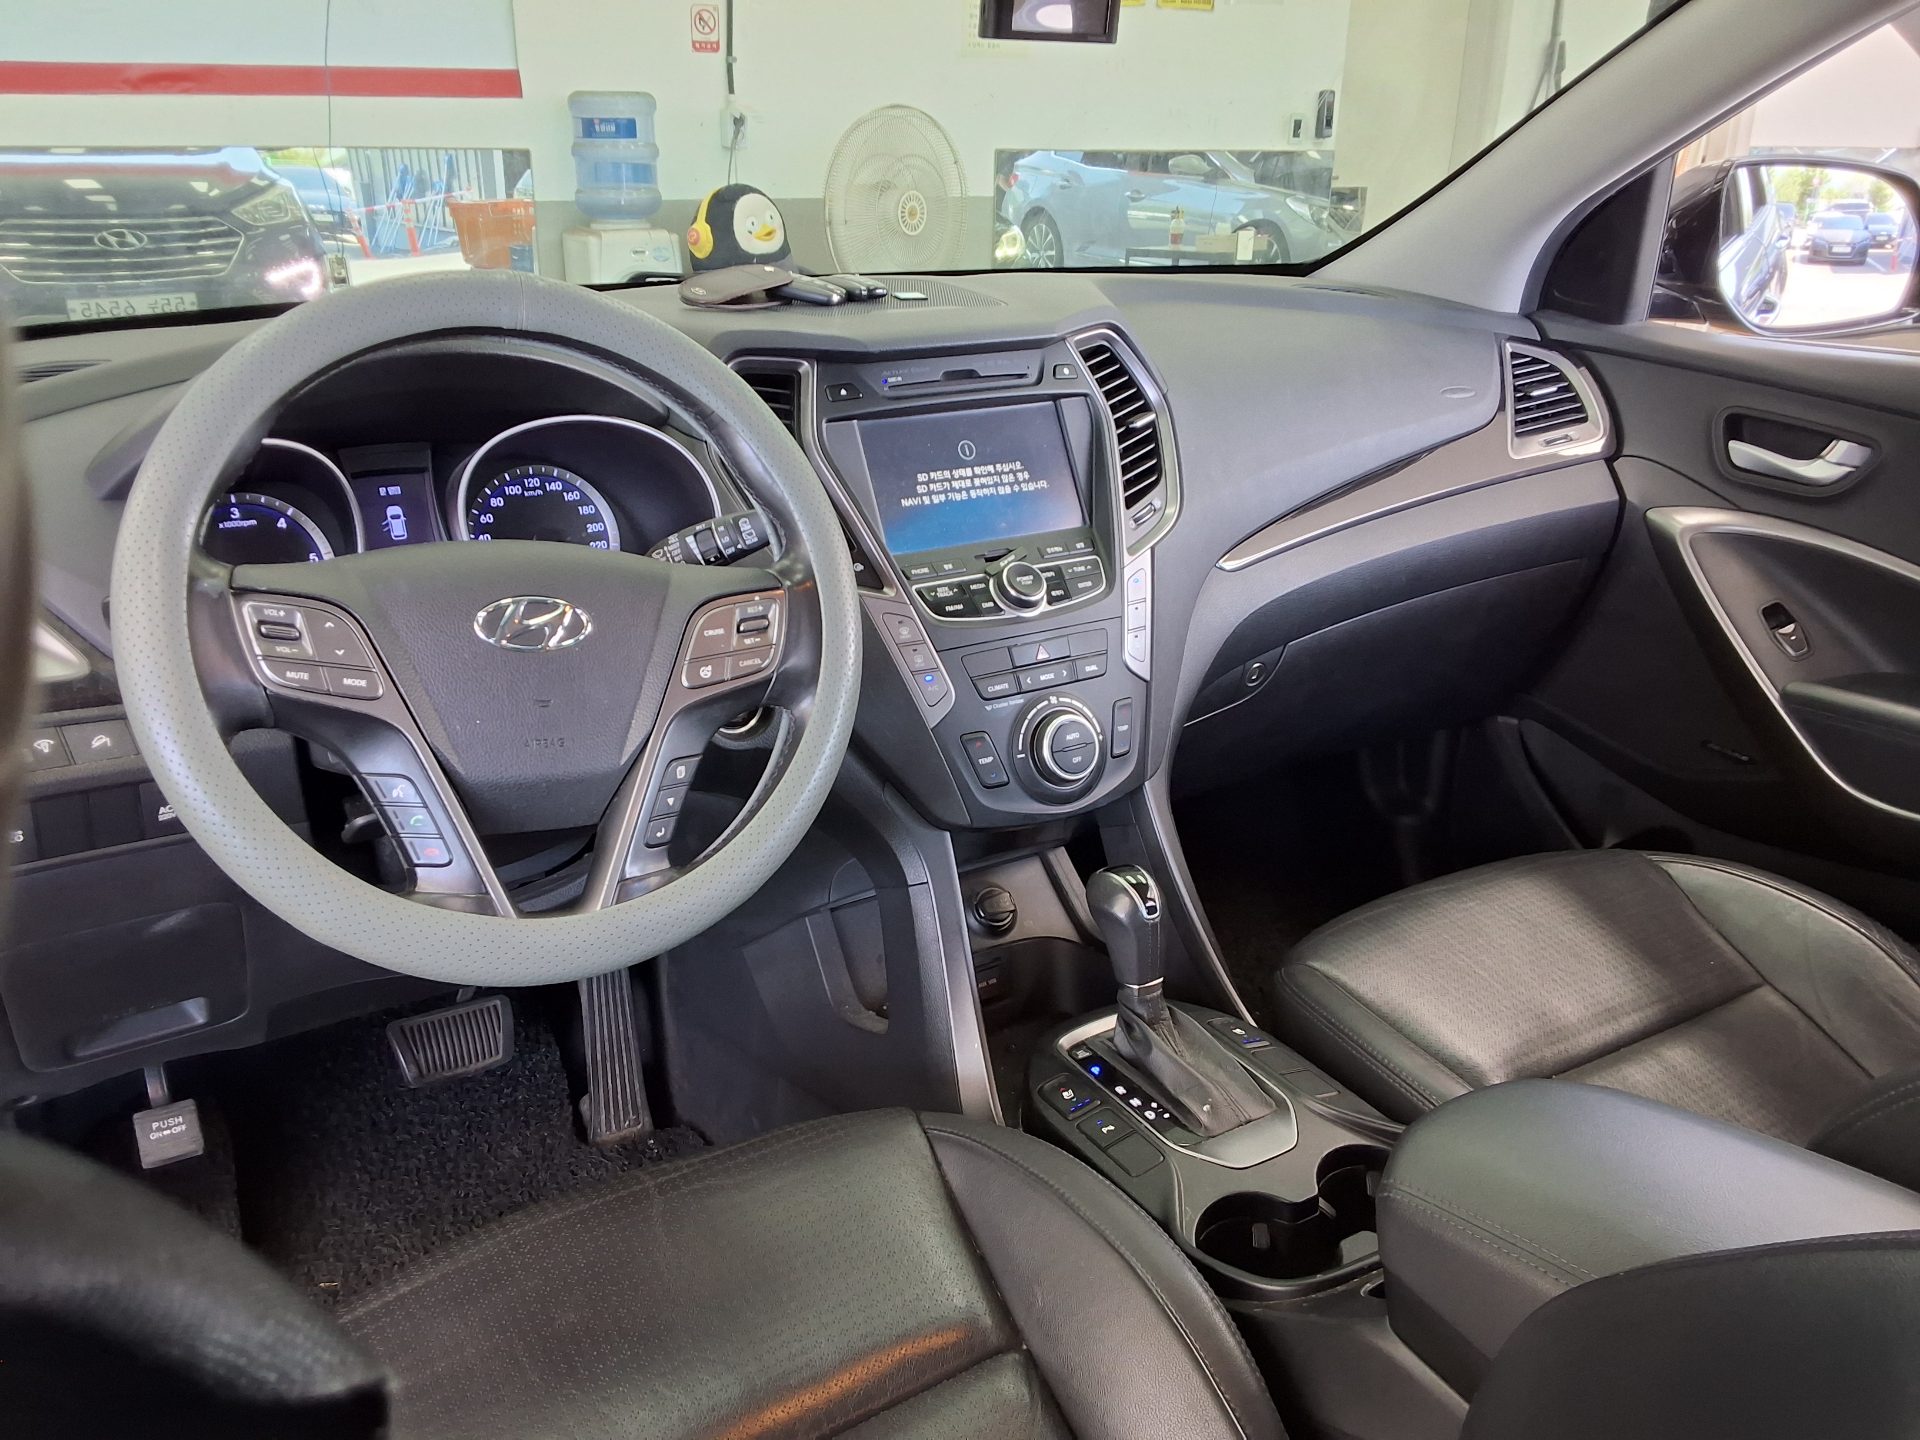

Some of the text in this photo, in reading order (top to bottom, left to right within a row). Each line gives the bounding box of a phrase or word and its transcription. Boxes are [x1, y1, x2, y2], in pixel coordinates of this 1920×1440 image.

[917, 473, 929, 482] SD
[930, 470, 951, 480] 카드의
[995, 461, 1024, 472] 주십시오.
[523, 477, 540, 488] 120
[544, 481, 563, 492] 140
[916, 484, 928, 494] SD
[929, 481, 951, 492] 카드가
[1016, 471, 1030, 481] 경우
[503, 484, 522, 496] 100
[523, 489, 544, 497] km/h
[563, 490, 580, 501] 160
[901, 497, 922, 507] NAVI
[948, 492, 969, 502] 기능은
[1012, 484, 1020, 493] 수
[1020, 480, 1050, 492] 있습니다.
[490, 496, 504, 507] 80
[230, 508, 240, 519] 3
[577, 504, 595, 515] 180
[276, 517, 287, 529] 4
[480, 513, 494, 524] 60
[586, 521, 605, 533] 200
[477, 533, 492, 541] 40
[589, 540, 608, 549] 220
[309, 552, 319, 563] 5
[739, 658, 762, 667] CANCEL
[1085, 663, 1098, 672] DUAL
[286, 671, 310, 680] MUTE
[1039, 672, 1055, 681] MODE
[343, 677, 368, 687] MODE
[987, 681, 1009, 693] CLIMATE
[1066, 732, 1080, 740] AUTO
[523, 736, 566, 749] AIRBAG
[978, 756, 994, 766] TEMP
[1144, 1110, 1156, 1120] D
[151, 1115, 183, 1131] PUSH
[171, 1123, 187, 1134] OFF
